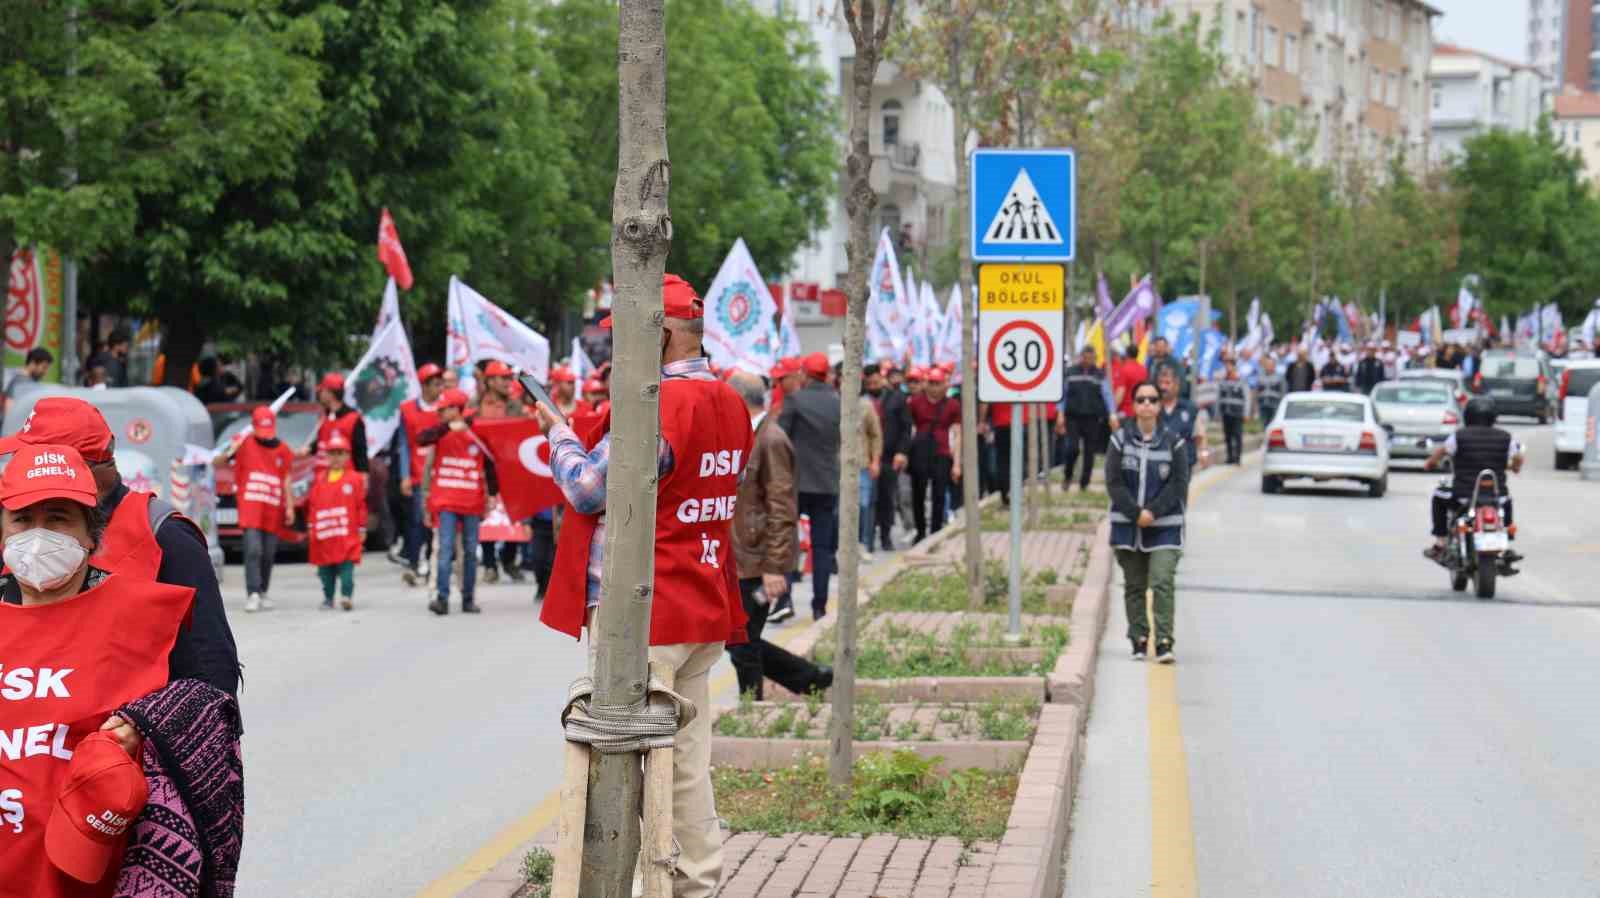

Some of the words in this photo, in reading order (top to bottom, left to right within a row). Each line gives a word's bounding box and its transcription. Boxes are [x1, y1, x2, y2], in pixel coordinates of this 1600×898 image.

[1000, 272, 1044, 284] OKUL
[987, 287, 1057, 304] BÖLGESİ
[1001, 341, 1041, 371] 30
[34, 451, 67, 466] DİSK
[676, 496, 736, 524] GENE
[700, 532, 720, 569] İŞ
[0, 664, 74, 700] SK
[0, 788, 25, 833] Ş
